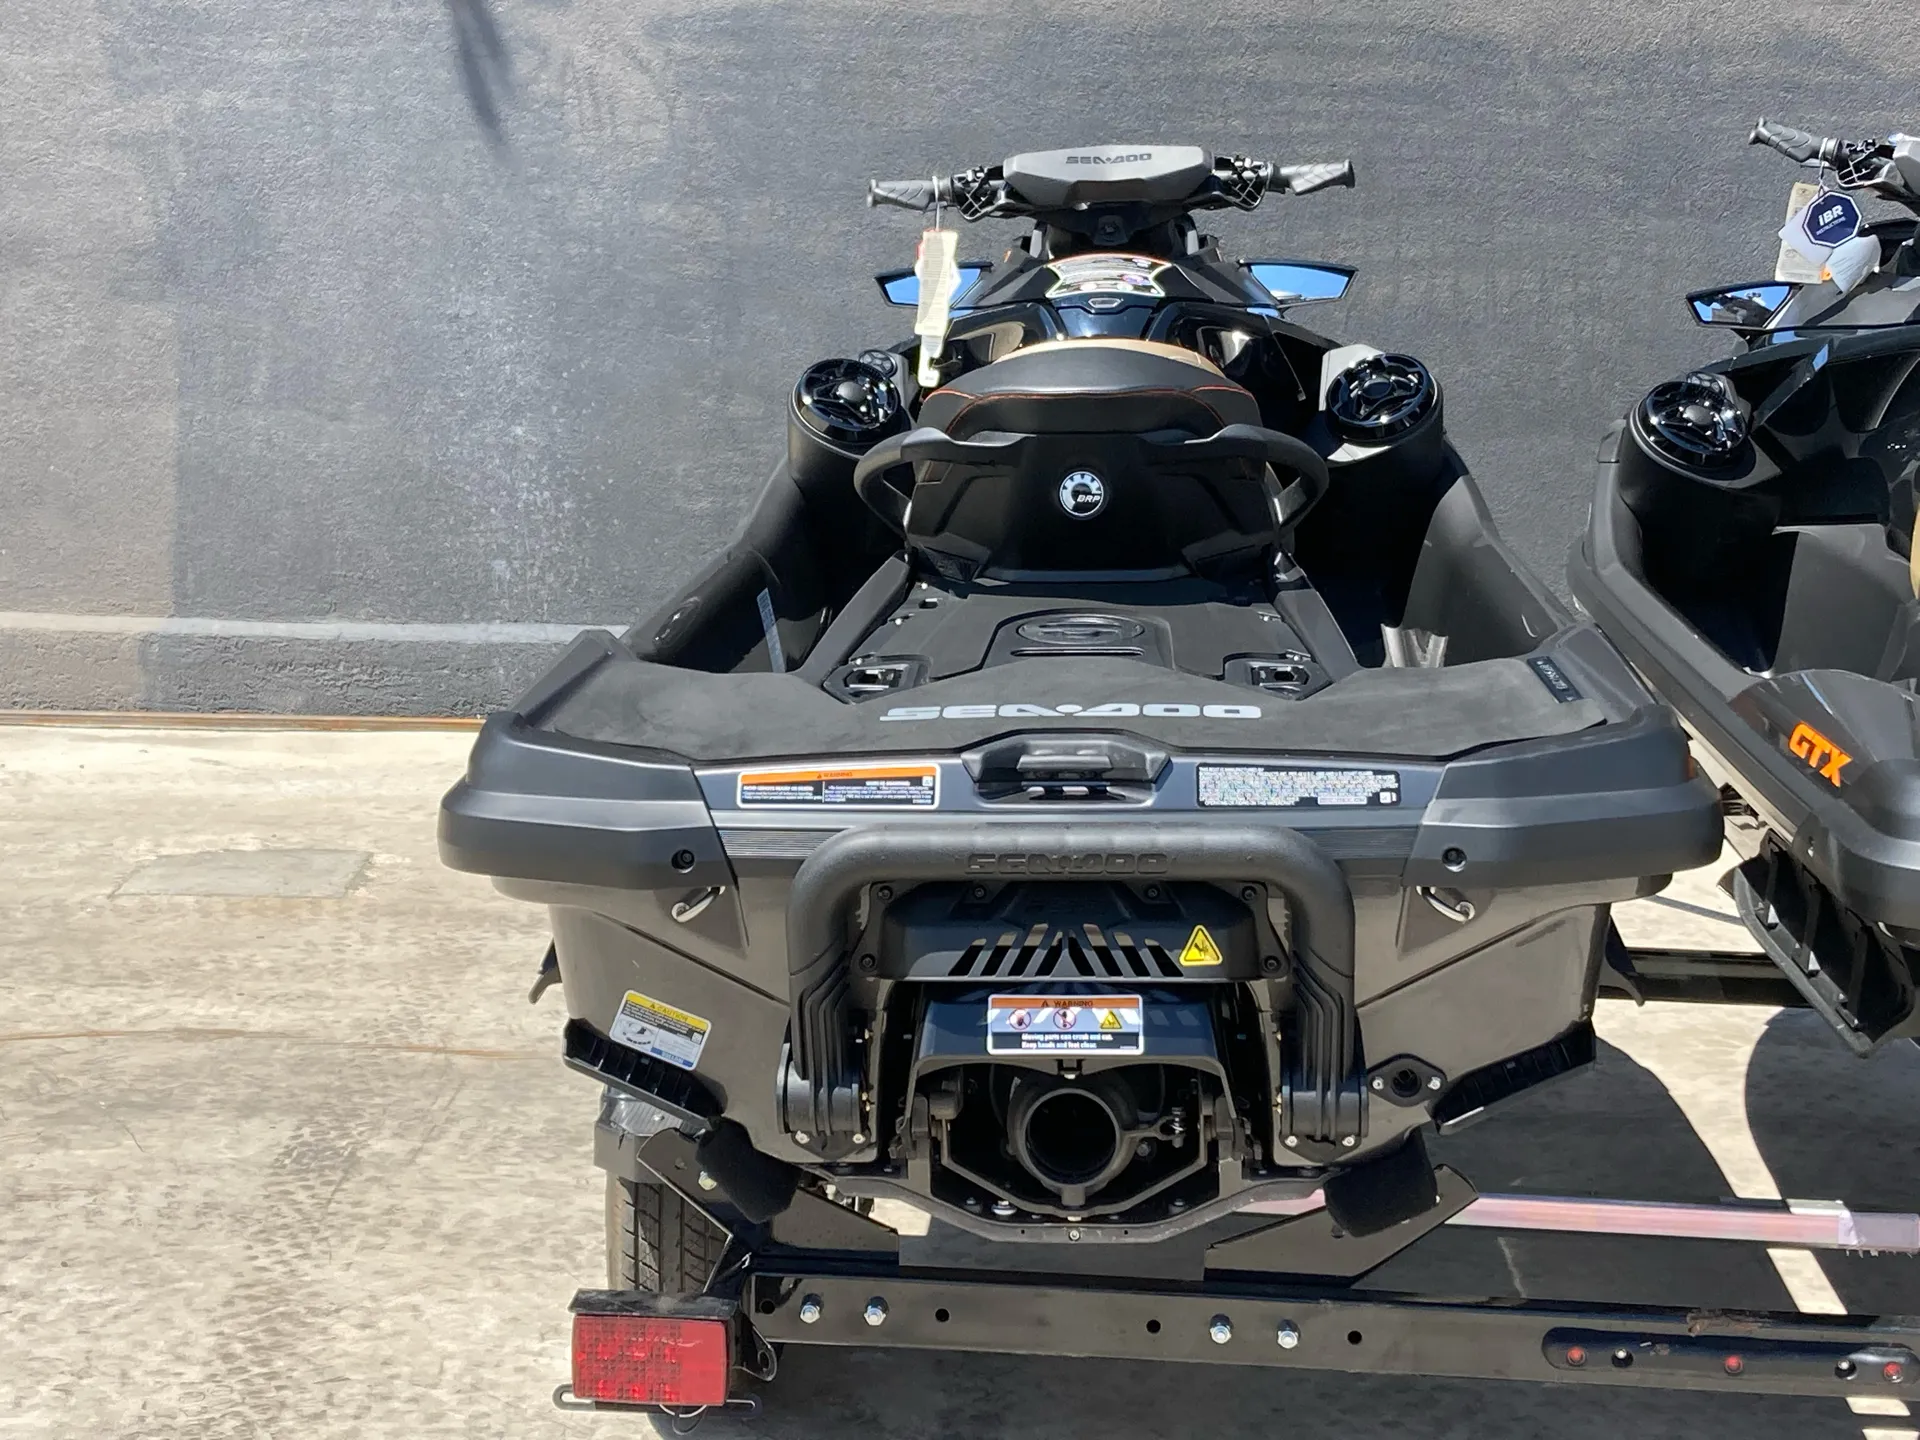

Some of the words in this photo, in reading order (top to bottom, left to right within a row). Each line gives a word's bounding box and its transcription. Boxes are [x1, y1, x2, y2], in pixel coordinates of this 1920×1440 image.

[1818, 205, 1844, 226] IBR
[1077, 495, 1101, 503] BRP
[1788, 721, 1854, 788] GTX
[657, 1004, 689, 1022] CAUTION
[1053, 1000, 1094, 1008] WARNING
